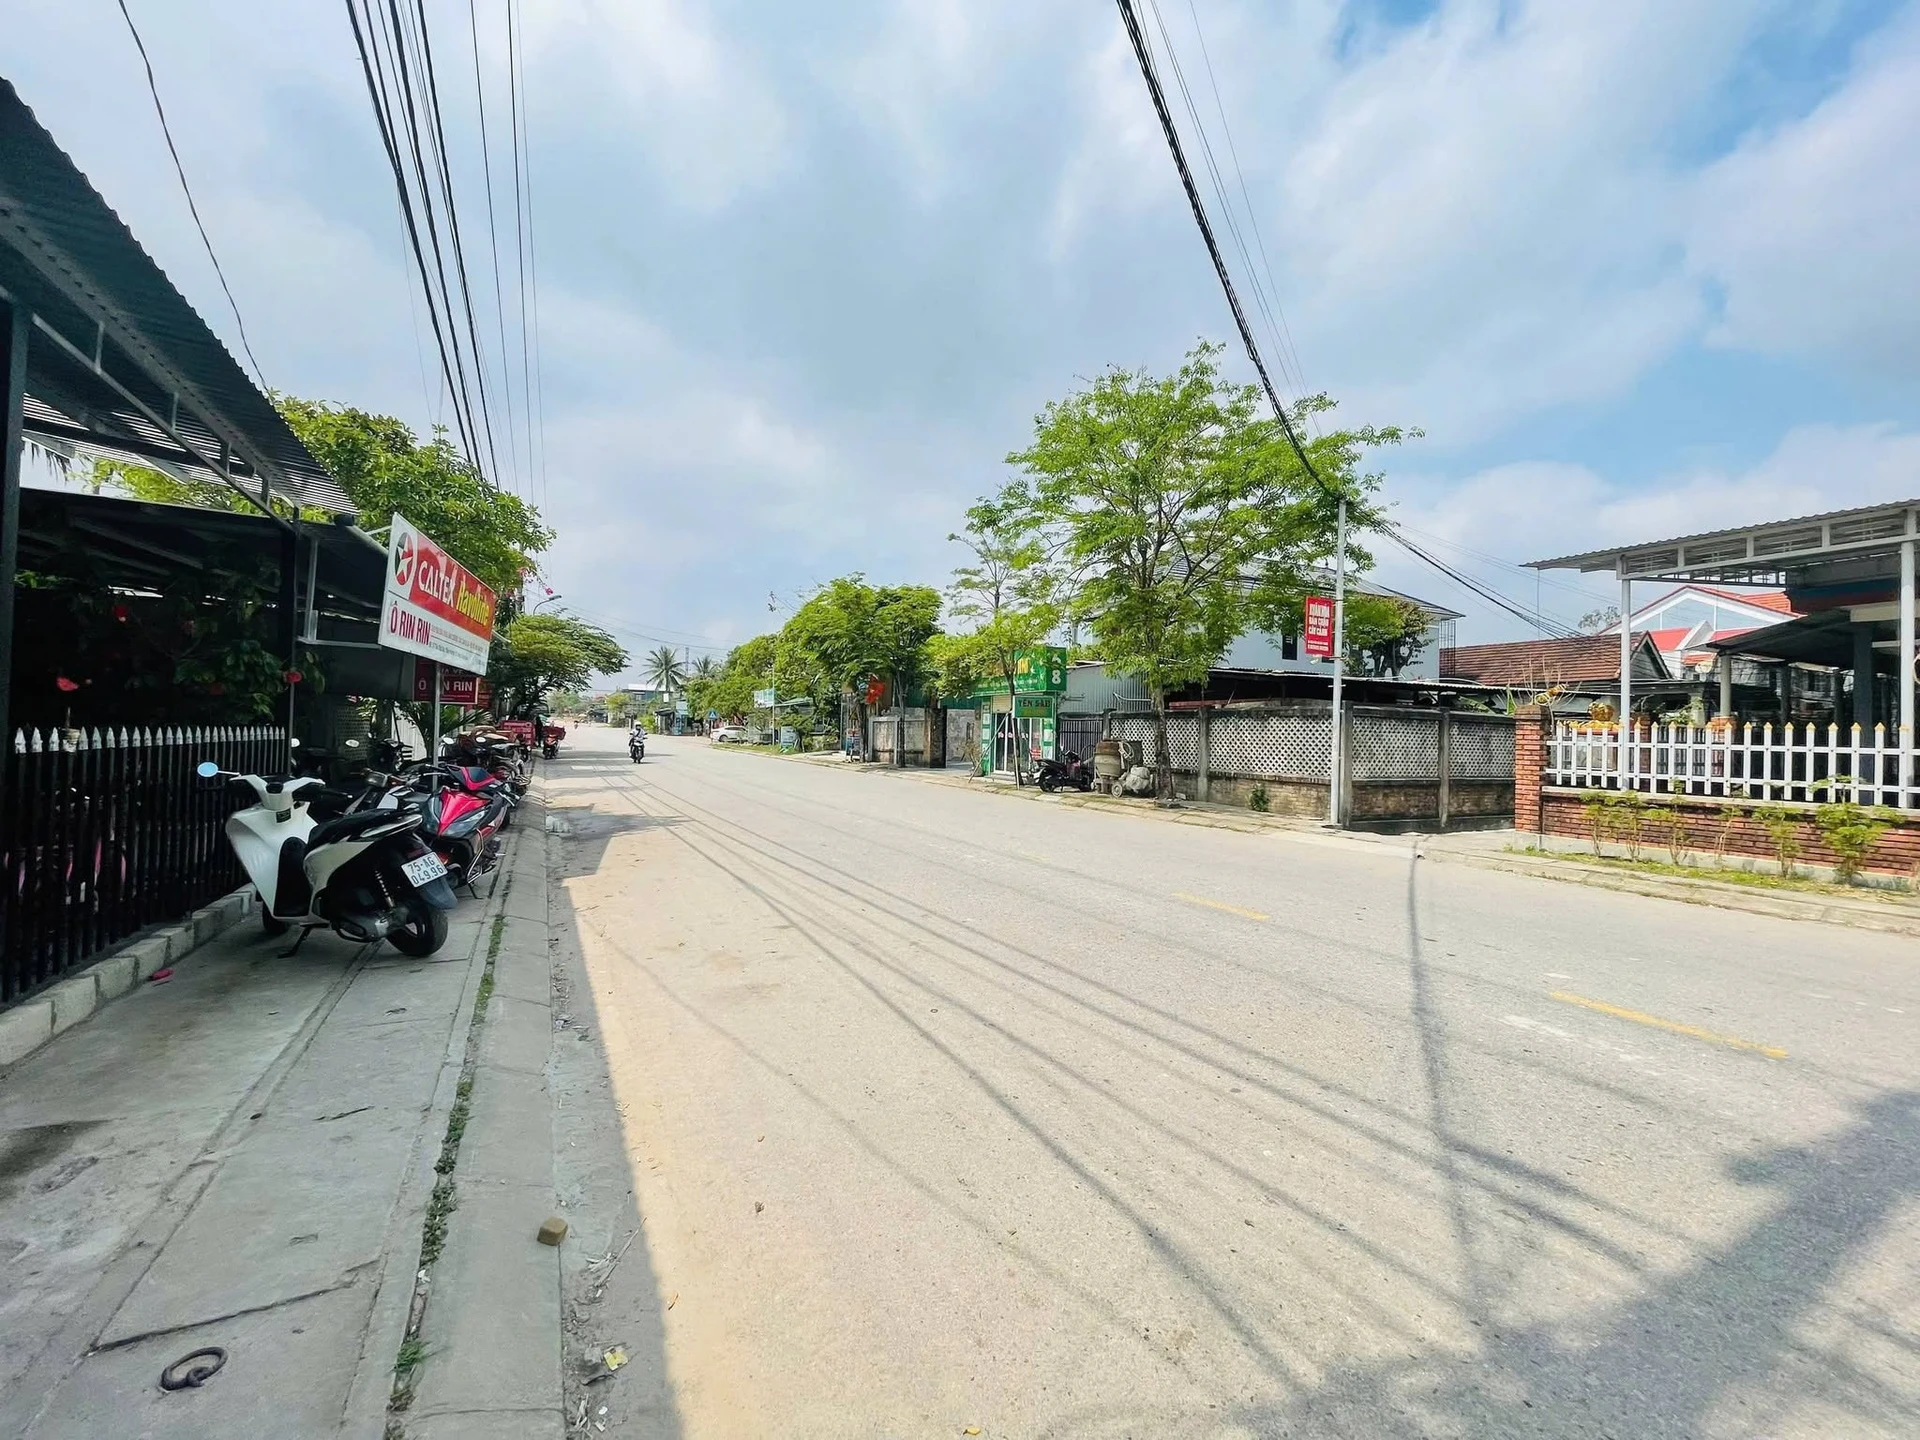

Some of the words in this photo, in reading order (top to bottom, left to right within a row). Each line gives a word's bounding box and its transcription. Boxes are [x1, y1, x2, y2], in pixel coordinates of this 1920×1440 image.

[418, 560, 458, 608] CALTEX
[399, 610, 416, 640] RIN
[416, 617, 431, 646] RIN
[453, 680, 473, 692] RIN
[410, 864, 444, 885] 049.96
